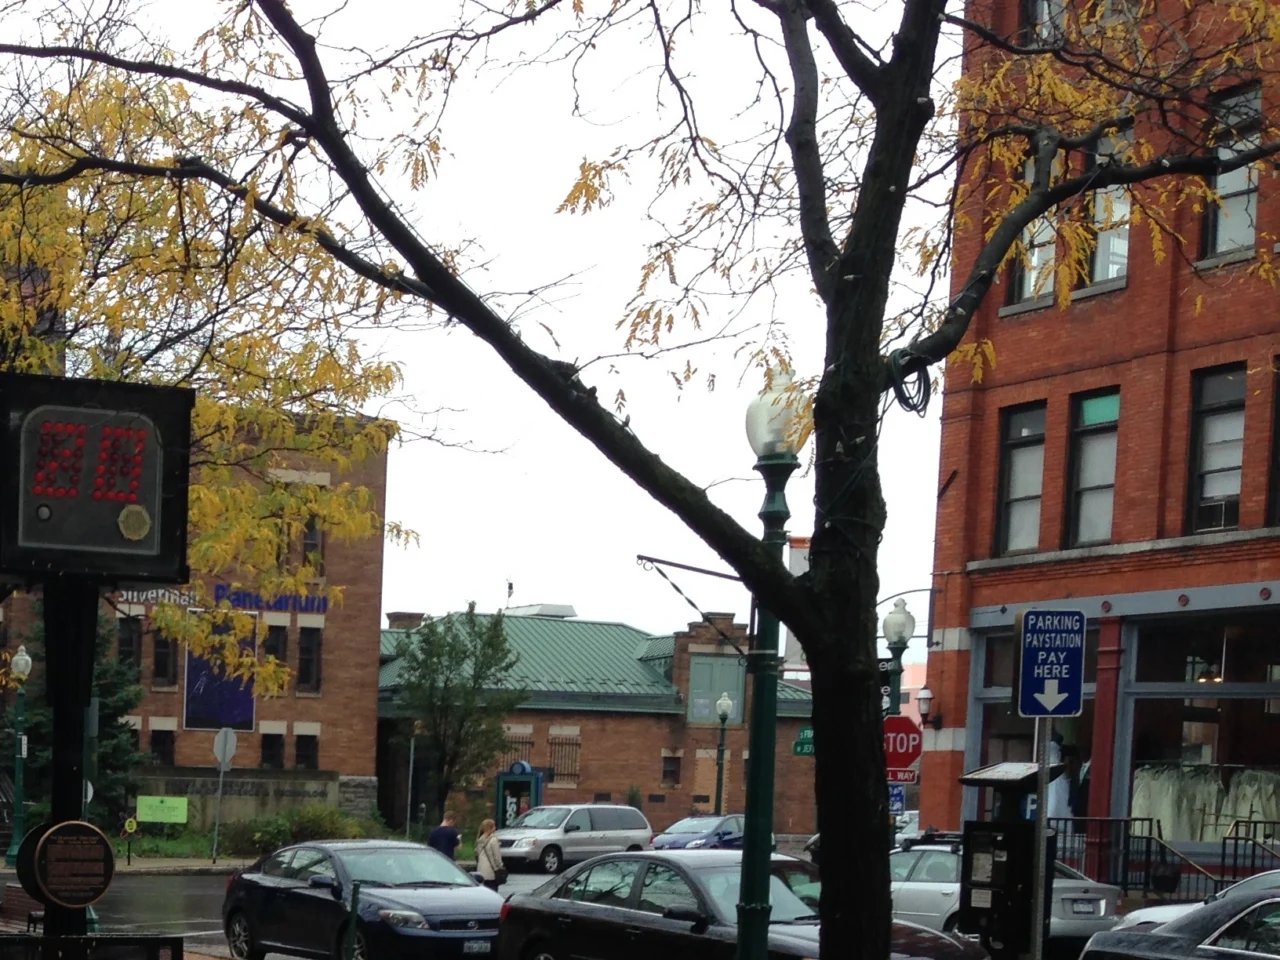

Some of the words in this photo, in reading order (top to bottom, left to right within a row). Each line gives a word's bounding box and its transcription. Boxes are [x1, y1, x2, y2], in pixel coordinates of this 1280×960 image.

[215, 584, 328, 613] Planearium
[1028, 615, 1081, 630] PARKING
[1025, 633, 1081, 648] PAYSTATION
[1038, 652, 1067, 664] PAY
[1034, 665, 1070, 678] HERE
[897, 771, 915, 780] WAY
